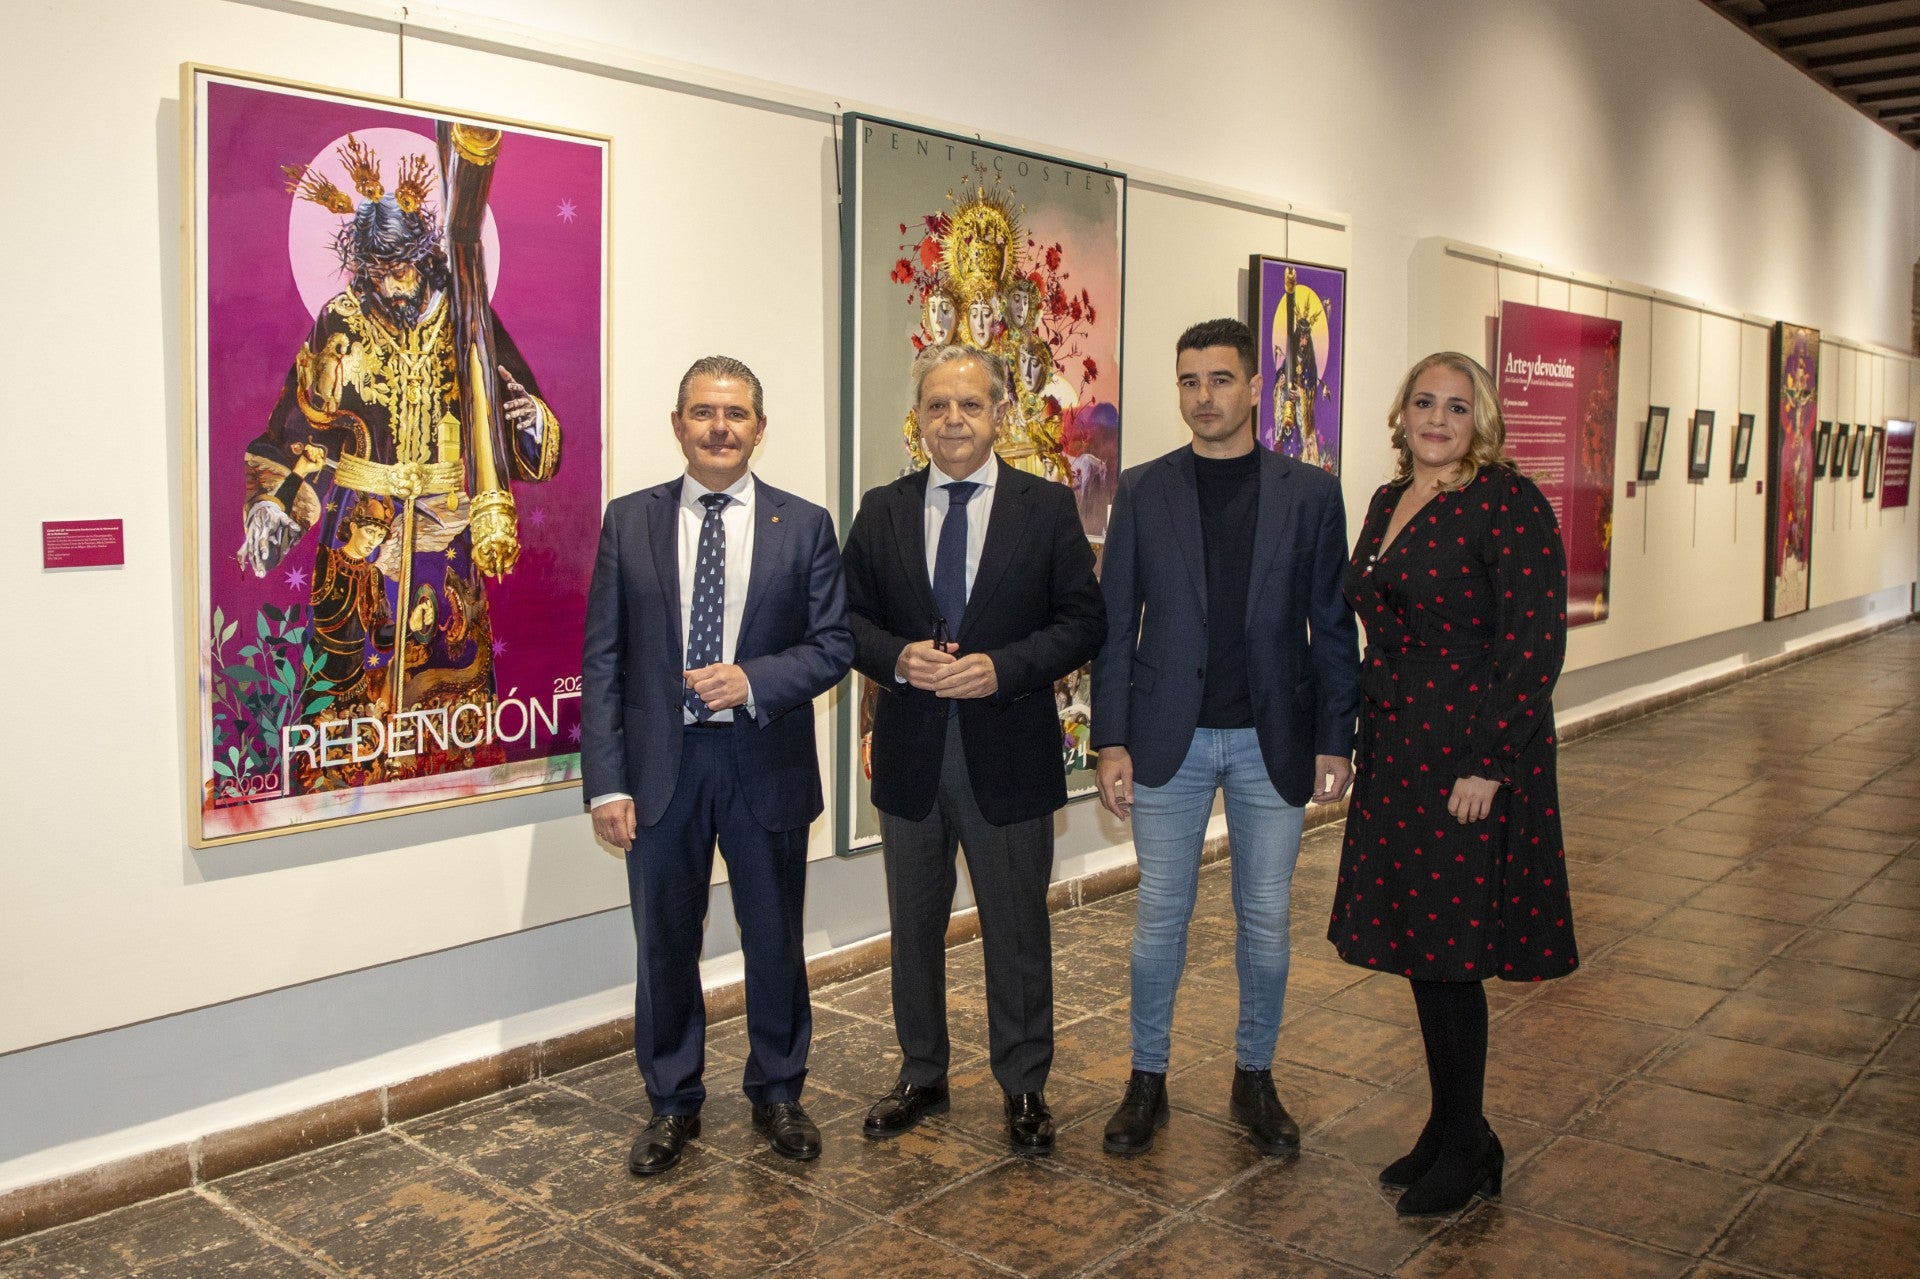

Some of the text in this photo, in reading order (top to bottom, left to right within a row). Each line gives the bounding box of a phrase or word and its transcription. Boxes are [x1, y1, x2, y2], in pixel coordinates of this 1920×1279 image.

[864, 127, 1112, 195] PENTECOSTÉS
[1504, 352, 1527, 374] Arte
[1534, 354, 1575, 379] devoción:
[282, 687, 559, 794] REDENCIÓN
[220, 773, 279, 797] 2000
